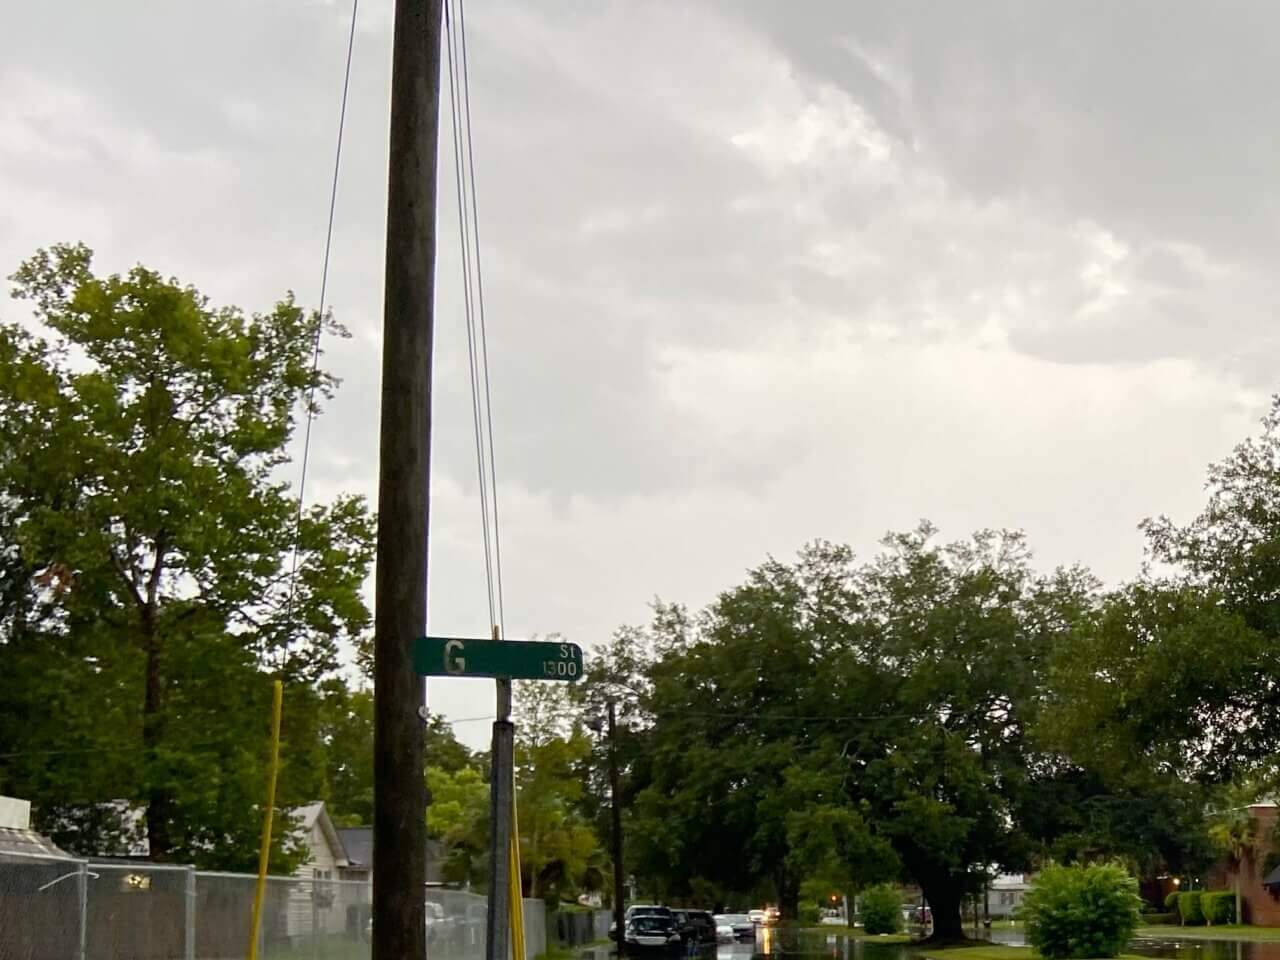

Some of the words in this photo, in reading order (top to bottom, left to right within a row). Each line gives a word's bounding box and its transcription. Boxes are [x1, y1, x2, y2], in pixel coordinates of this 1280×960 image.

[445, 640, 466, 674] G
[560, 644, 576, 659] St
[542, 661, 577, 676] 1300
